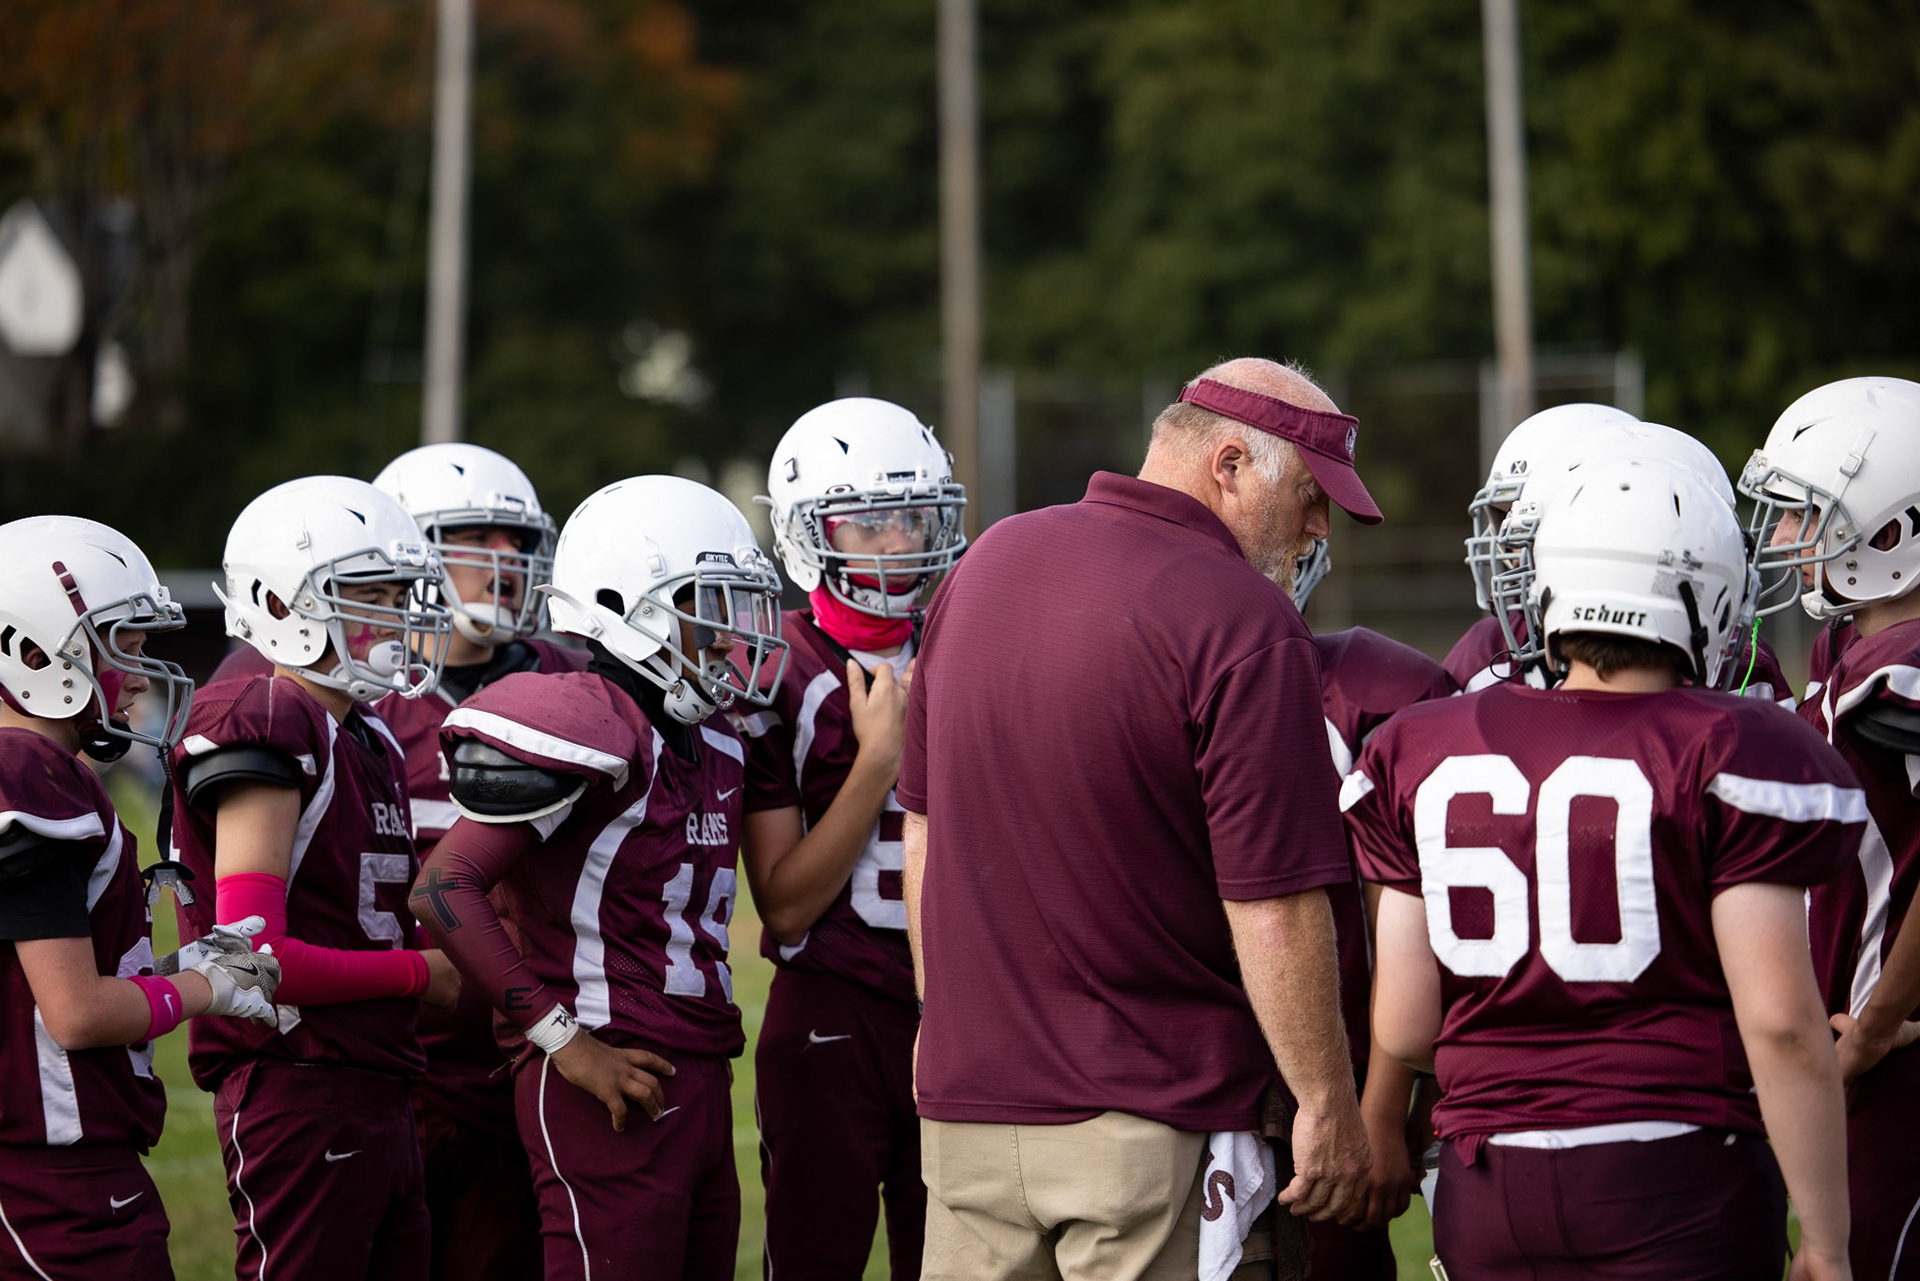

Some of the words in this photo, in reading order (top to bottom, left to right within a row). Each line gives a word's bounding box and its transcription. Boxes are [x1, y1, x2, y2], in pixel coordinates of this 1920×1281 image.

[1572, 604, 1647, 626] schutt
[371, 802, 410, 838] RA
[686, 812, 729, 845] RAMS
[1414, 754, 1662, 983] 60
[505, 986, 533, 1011] E
